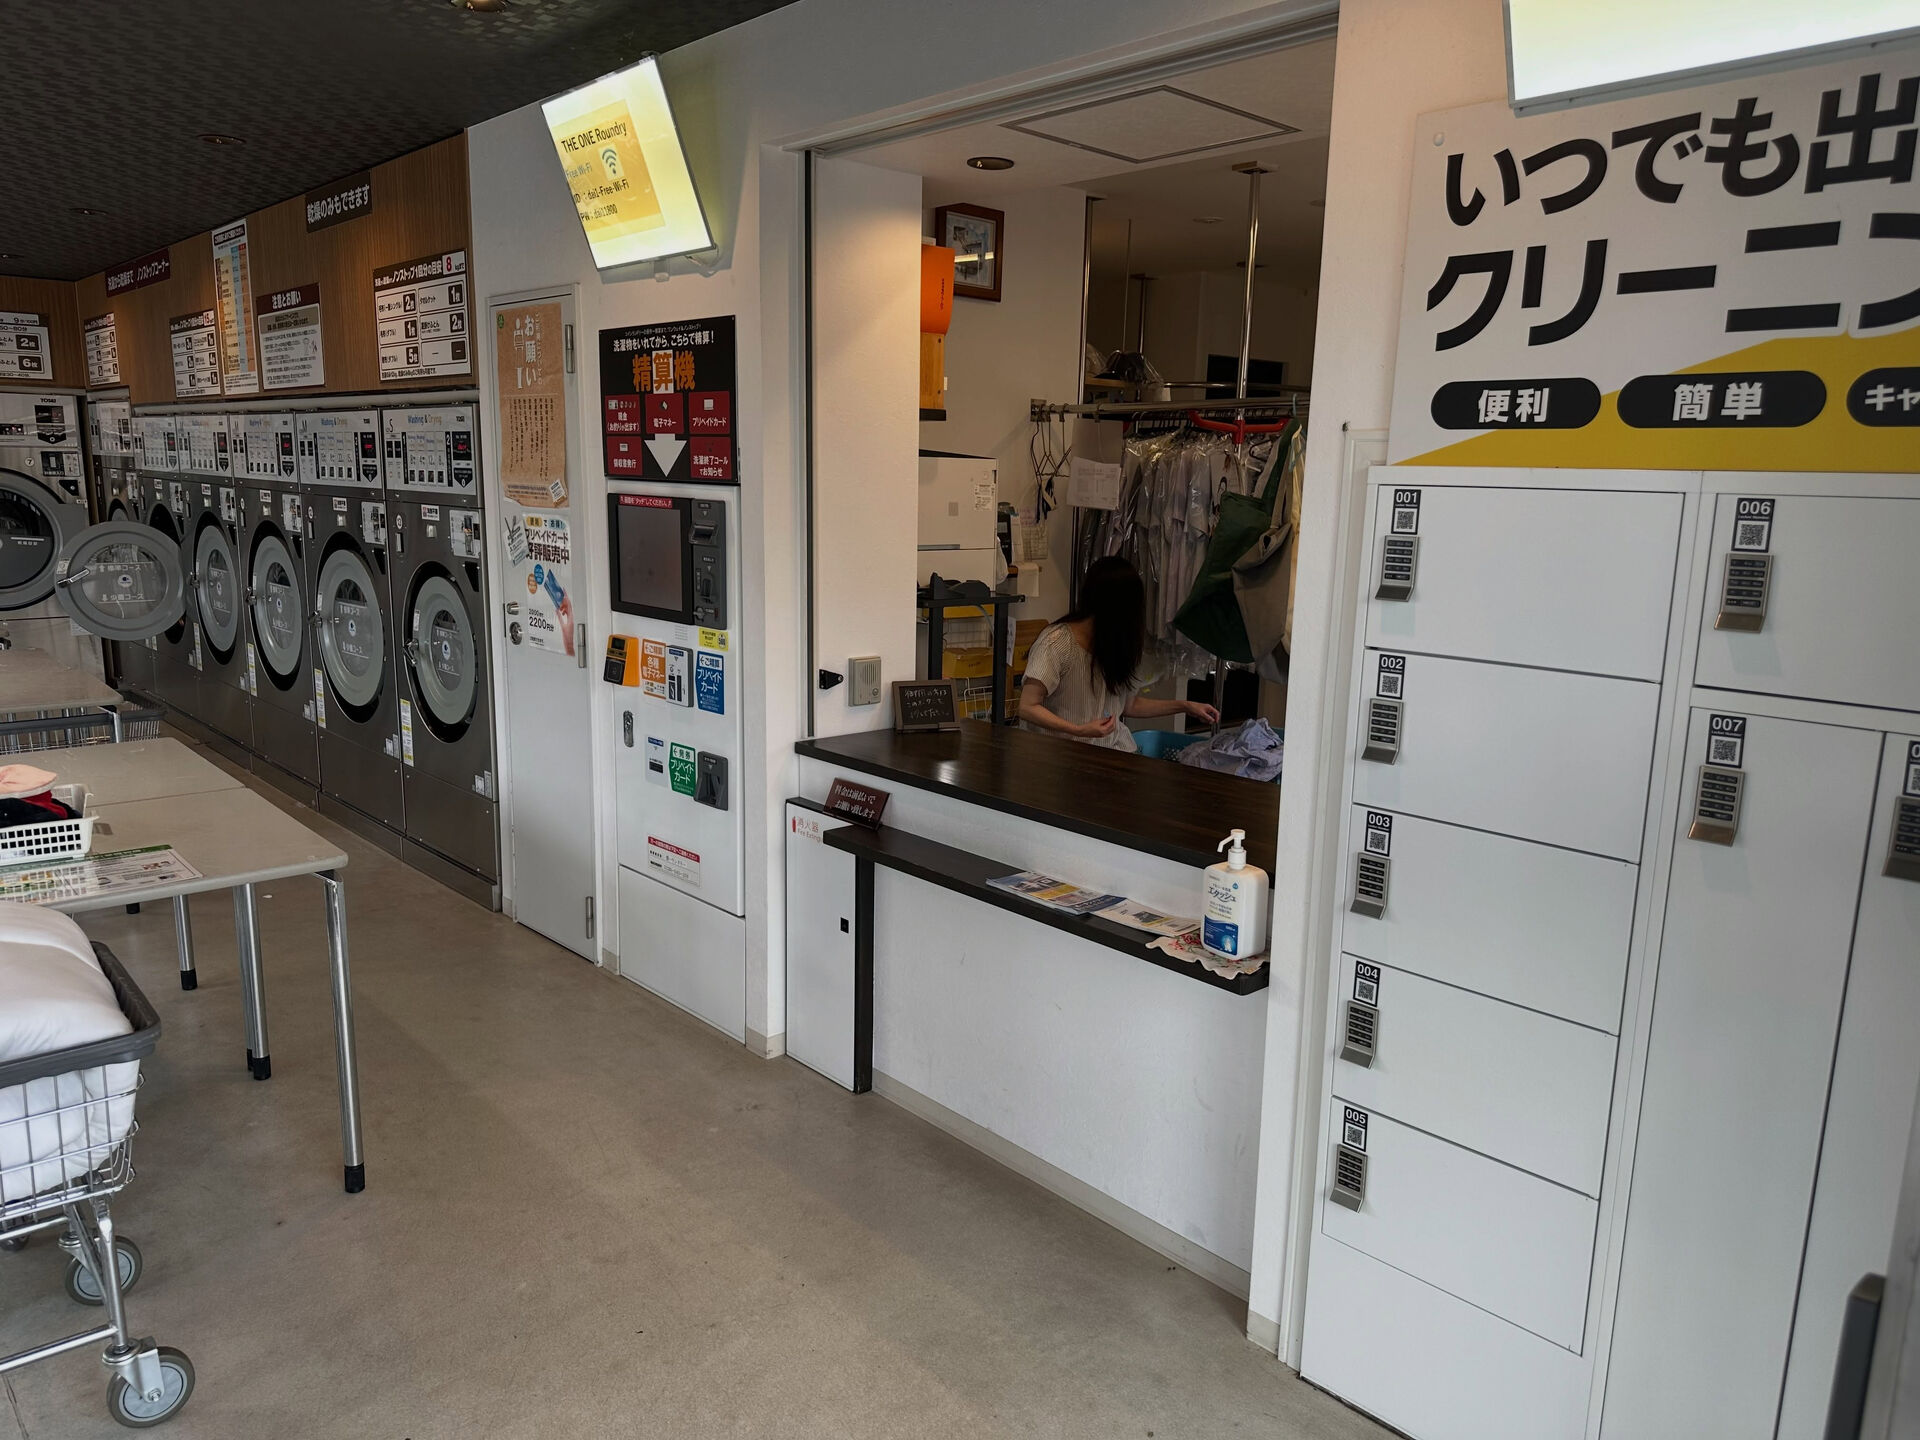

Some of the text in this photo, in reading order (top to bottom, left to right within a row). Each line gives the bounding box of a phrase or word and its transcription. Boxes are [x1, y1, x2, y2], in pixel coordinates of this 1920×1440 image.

[561, 121, 628, 153] THE ONE Roundry
[306, 183, 370, 223] 乾燥のみもできます
[446, 256, 452, 272] 8
[524, 314, 538, 387] お願い
[632, 350, 696, 392] 精算機
[1477, 386, 1550, 424] 便利
[1672, 381, 1764, 422] 簡単
[653, 417, 677, 428] 電子マネー
[692, 417, 727, 427] プリペイドカード
[1396, 491, 1418, 504] 001
[1739, 500, 1772, 515] 006
[1381, 656, 1404, 669] 002
[697, 668, 722, 684] プリペイド
[700, 681, 719, 694] カード
[1712, 717, 1743, 733] 007
[670, 759, 695, 774] プリペイド
[674, 771, 691, 784] カード
[1368, 814, 1391, 828] 003
[1357, 963, 1379, 978] 004
[1345, 1109, 1366, 1124] 005
